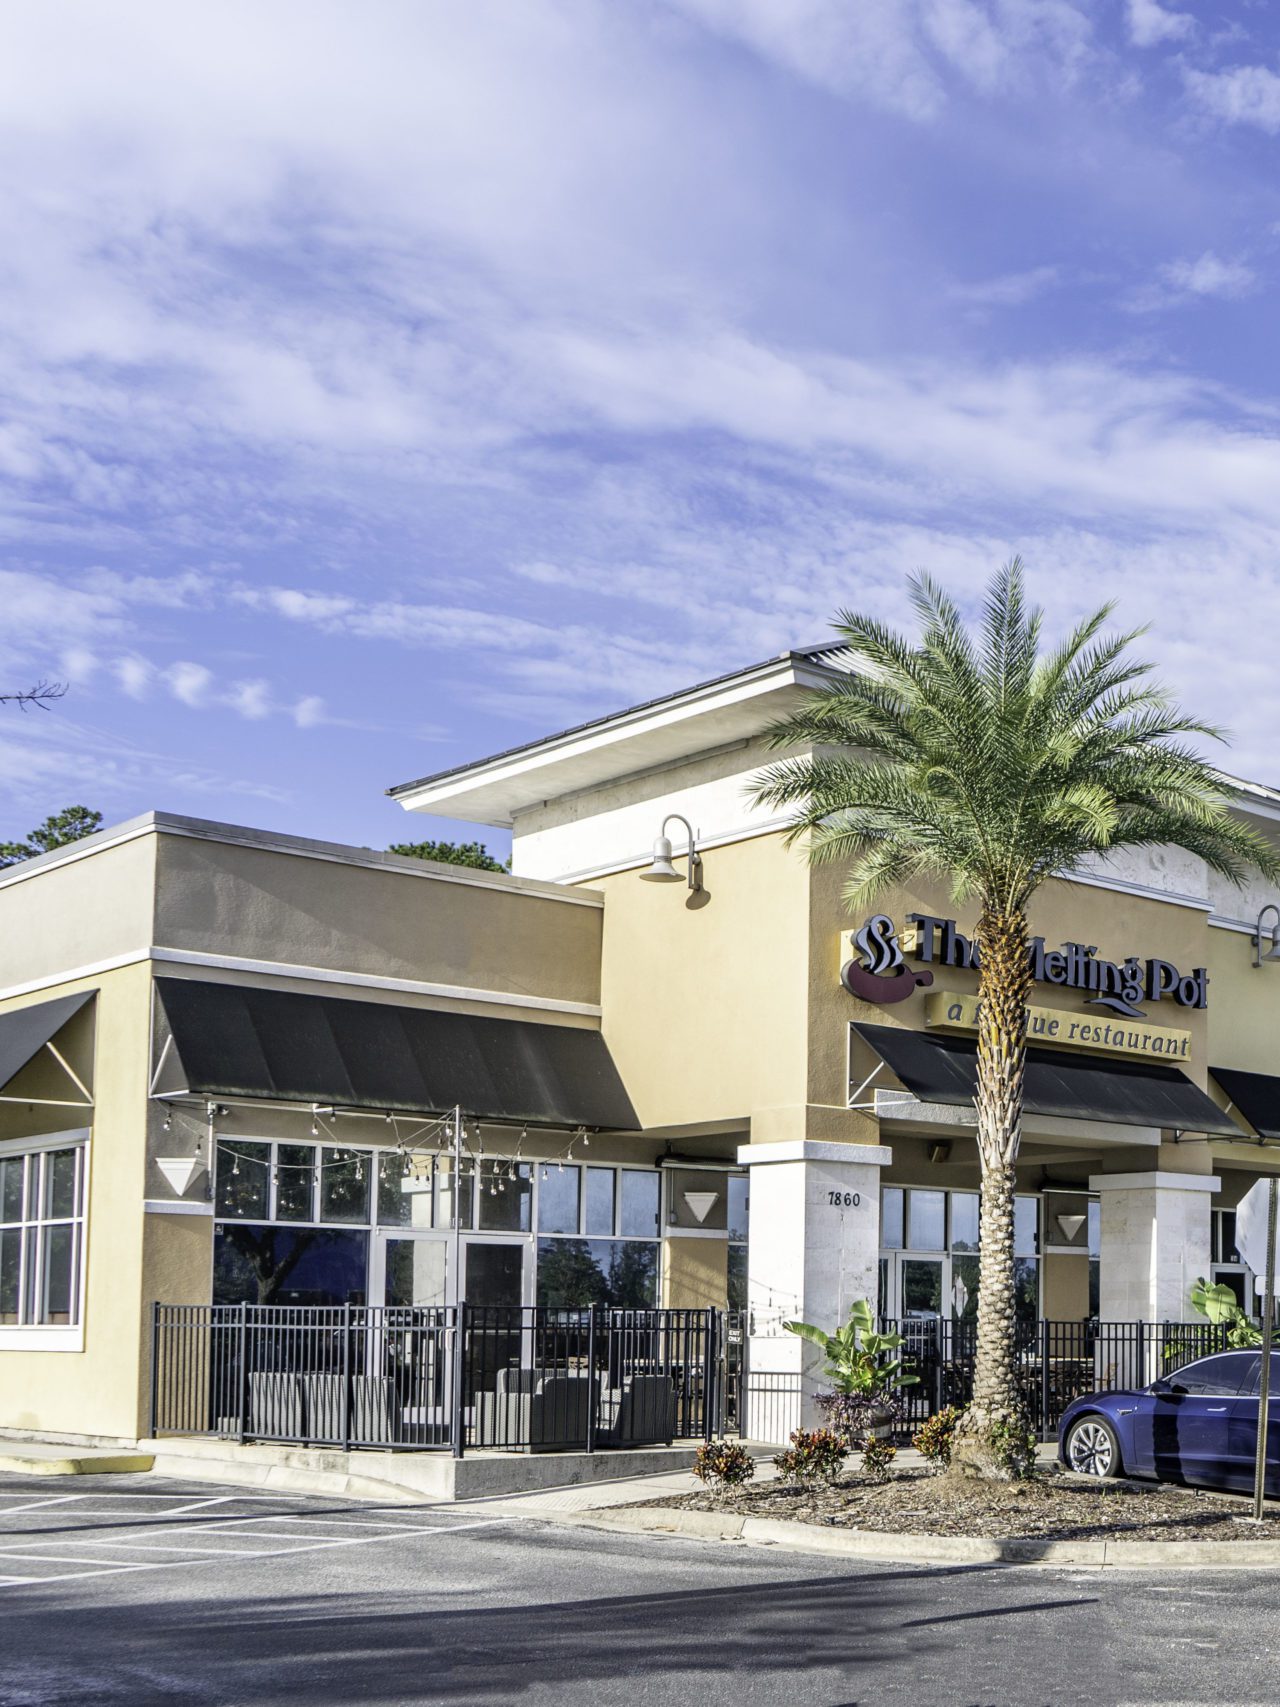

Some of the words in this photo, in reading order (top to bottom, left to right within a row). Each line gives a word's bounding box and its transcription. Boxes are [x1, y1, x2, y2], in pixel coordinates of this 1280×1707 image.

[1146, 959, 1210, 1008] Pot
[947, 1003, 963, 1021] a
[973, 1003, 1060, 1036] due
[1068, 1023, 1190, 1056] restaurant
[828, 1191, 860, 1207] 7860
